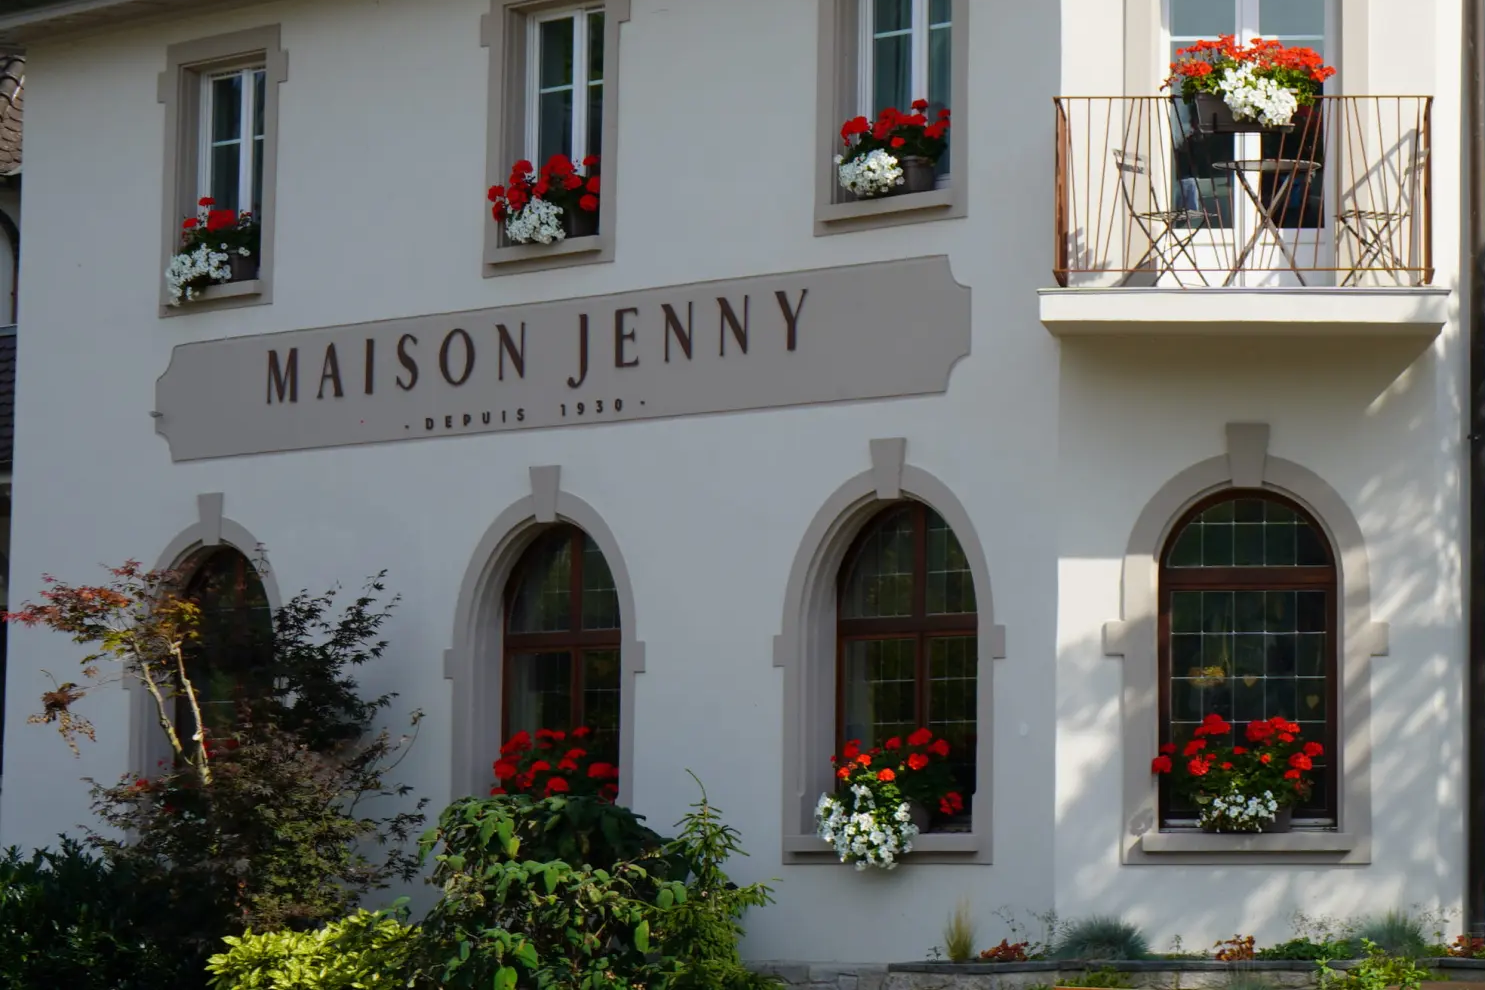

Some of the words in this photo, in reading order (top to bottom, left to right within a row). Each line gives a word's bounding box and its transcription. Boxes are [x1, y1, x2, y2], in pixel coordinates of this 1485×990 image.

[266, 322, 526, 404] MAISON
[567, 289, 808, 389] JENNY
[425, 408, 526, 431] DEPUIS
